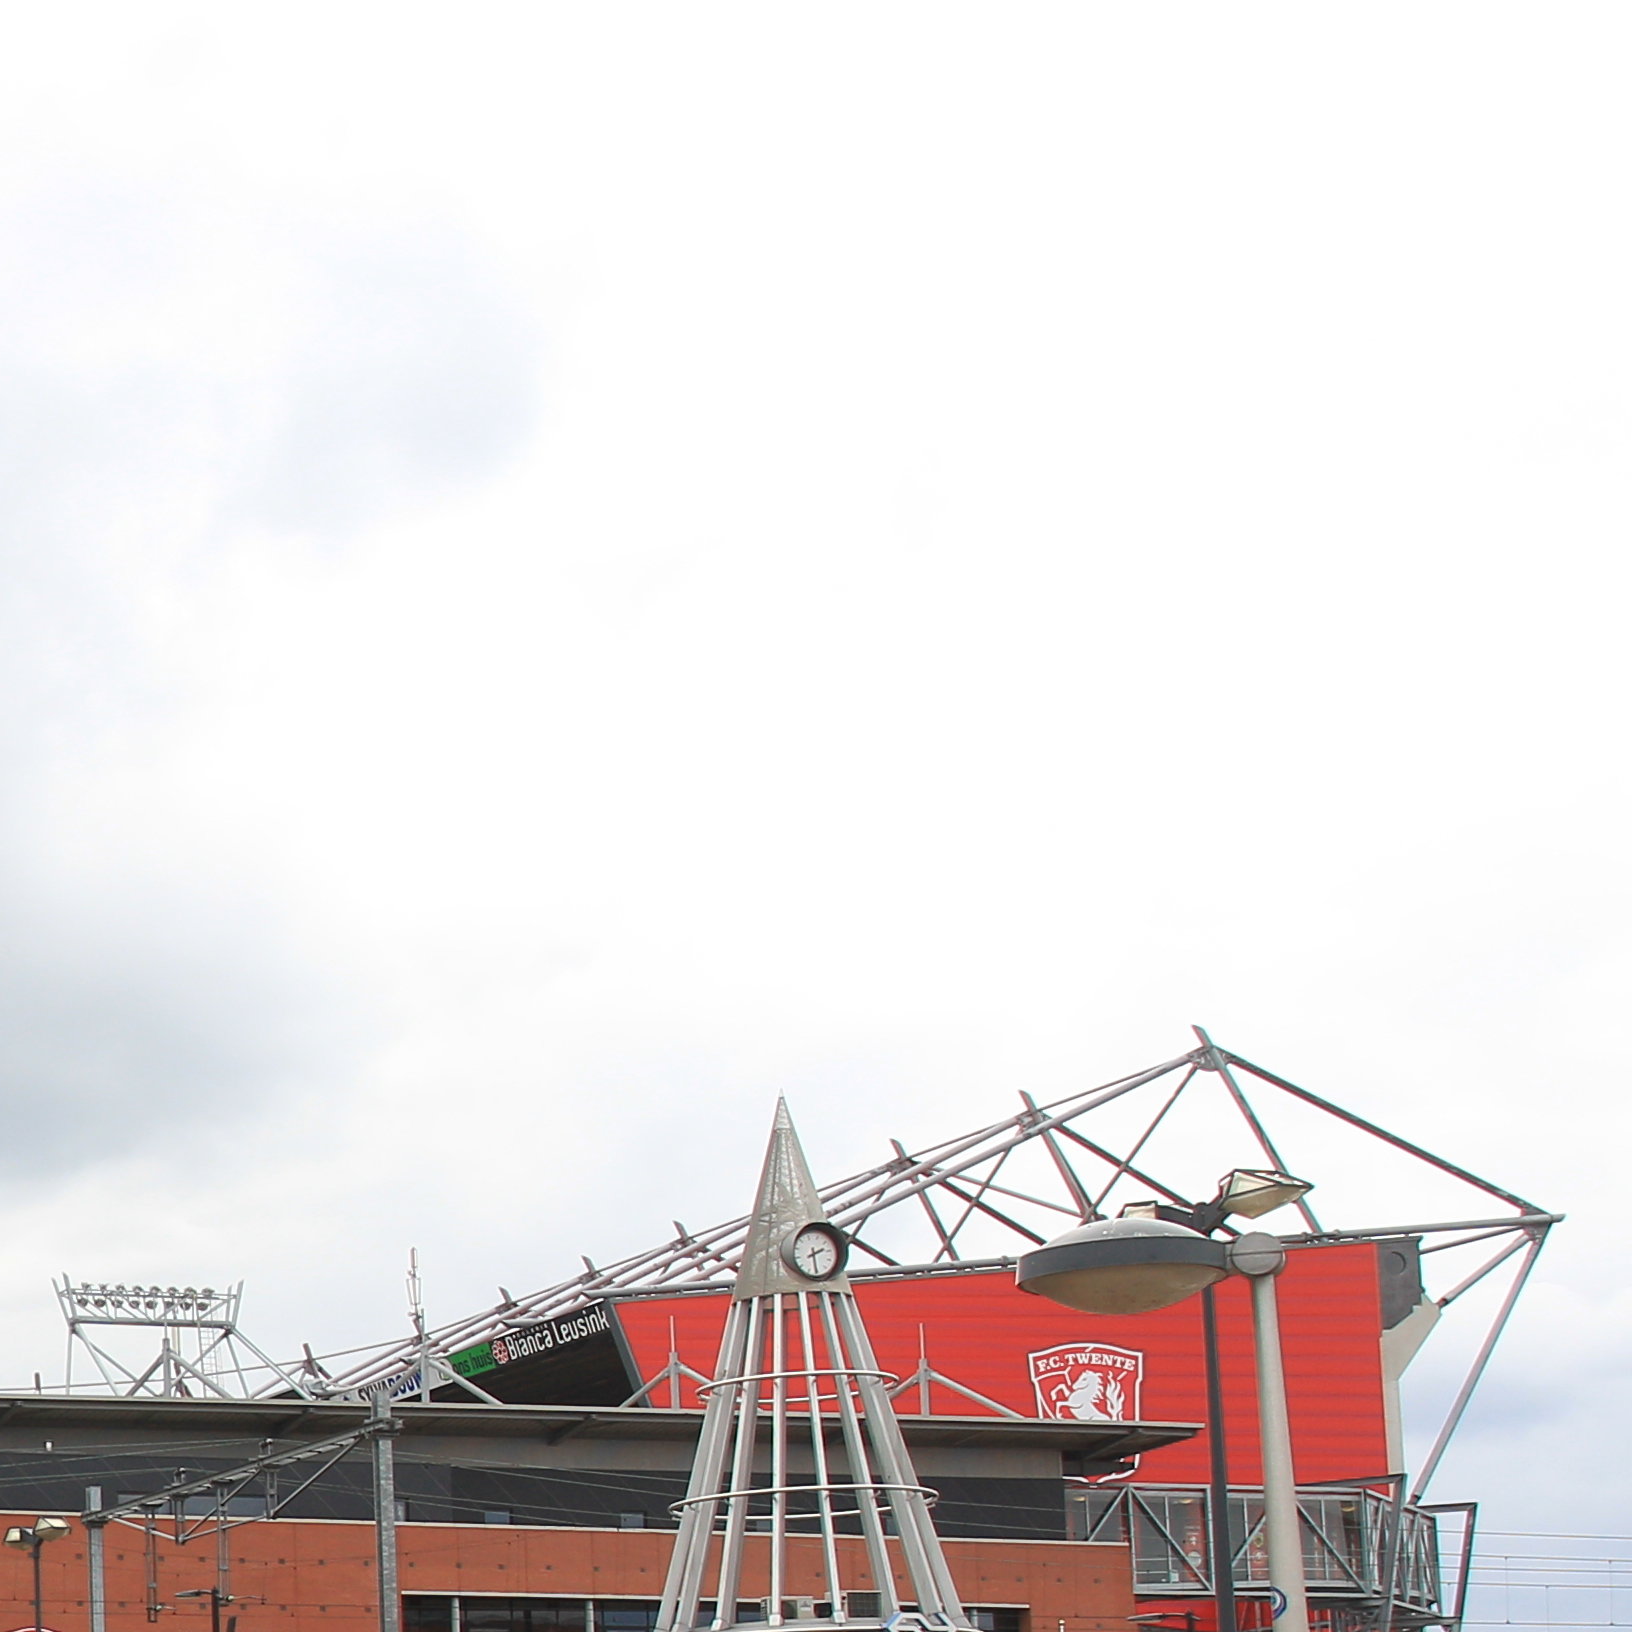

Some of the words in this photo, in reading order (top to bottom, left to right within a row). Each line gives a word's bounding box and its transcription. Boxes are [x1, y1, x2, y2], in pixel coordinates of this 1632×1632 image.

[504, 1329, 554, 1361] Bianca
[551, 1305, 610, 1345] Leusink
[1036, 1356, 1064, 1372] F.C.
[1064, 1353, 1136, 1371] TWENTE
